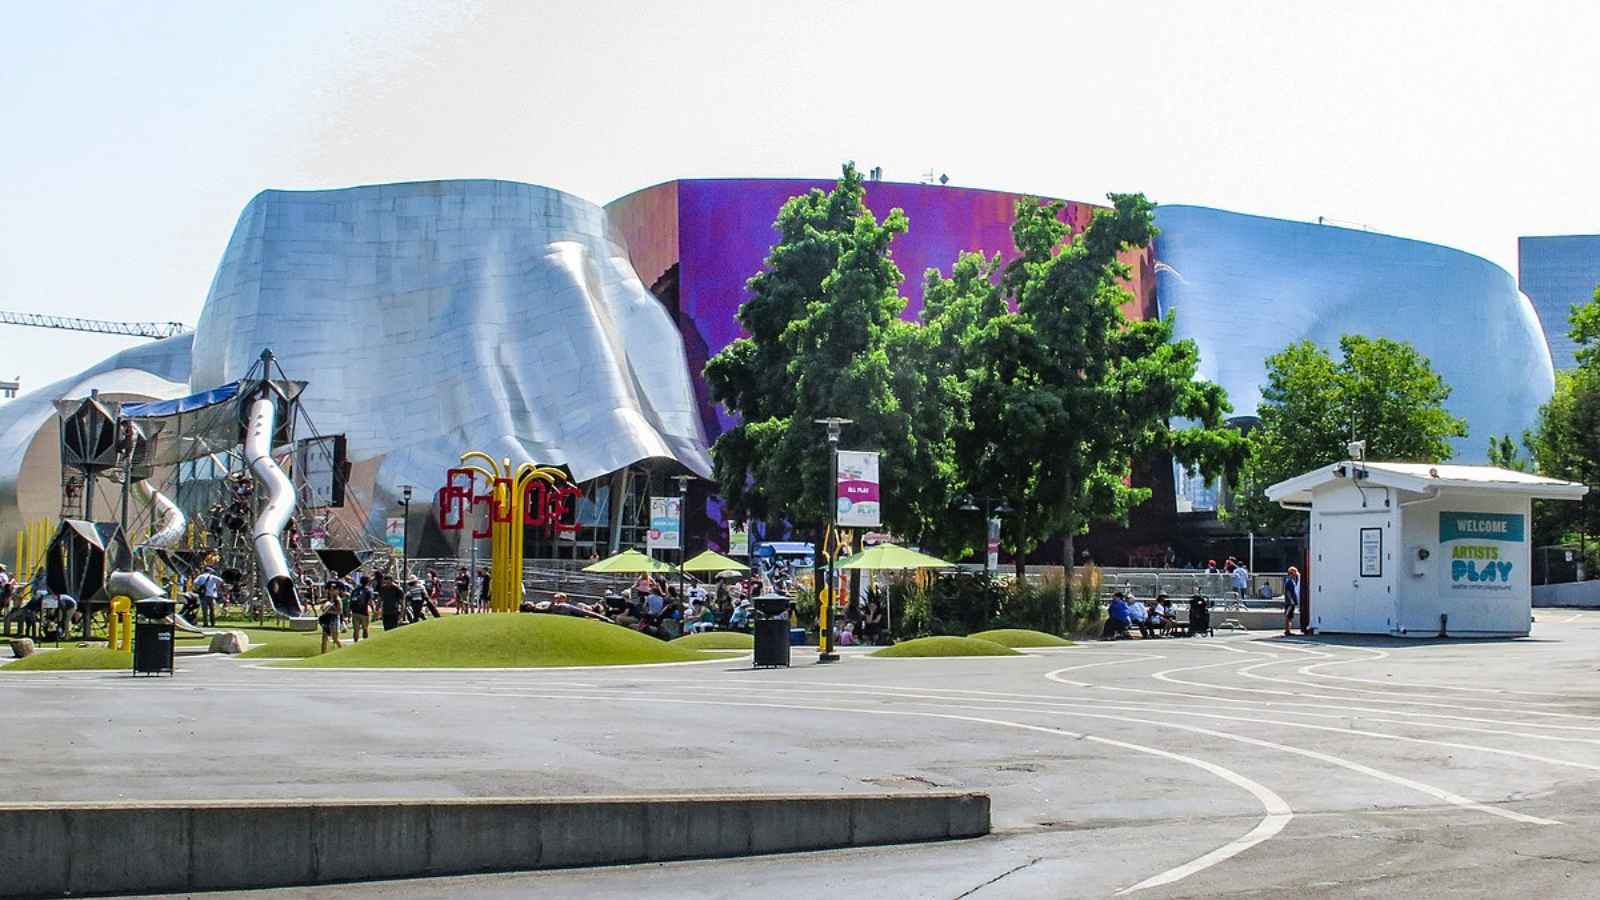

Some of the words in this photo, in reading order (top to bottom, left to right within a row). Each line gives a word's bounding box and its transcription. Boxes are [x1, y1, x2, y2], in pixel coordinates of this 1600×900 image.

[1456, 519, 1508, 533] WELCOME
[1452, 545, 1499, 560] ARTISTS
[1452, 560, 1513, 582] PLAY
